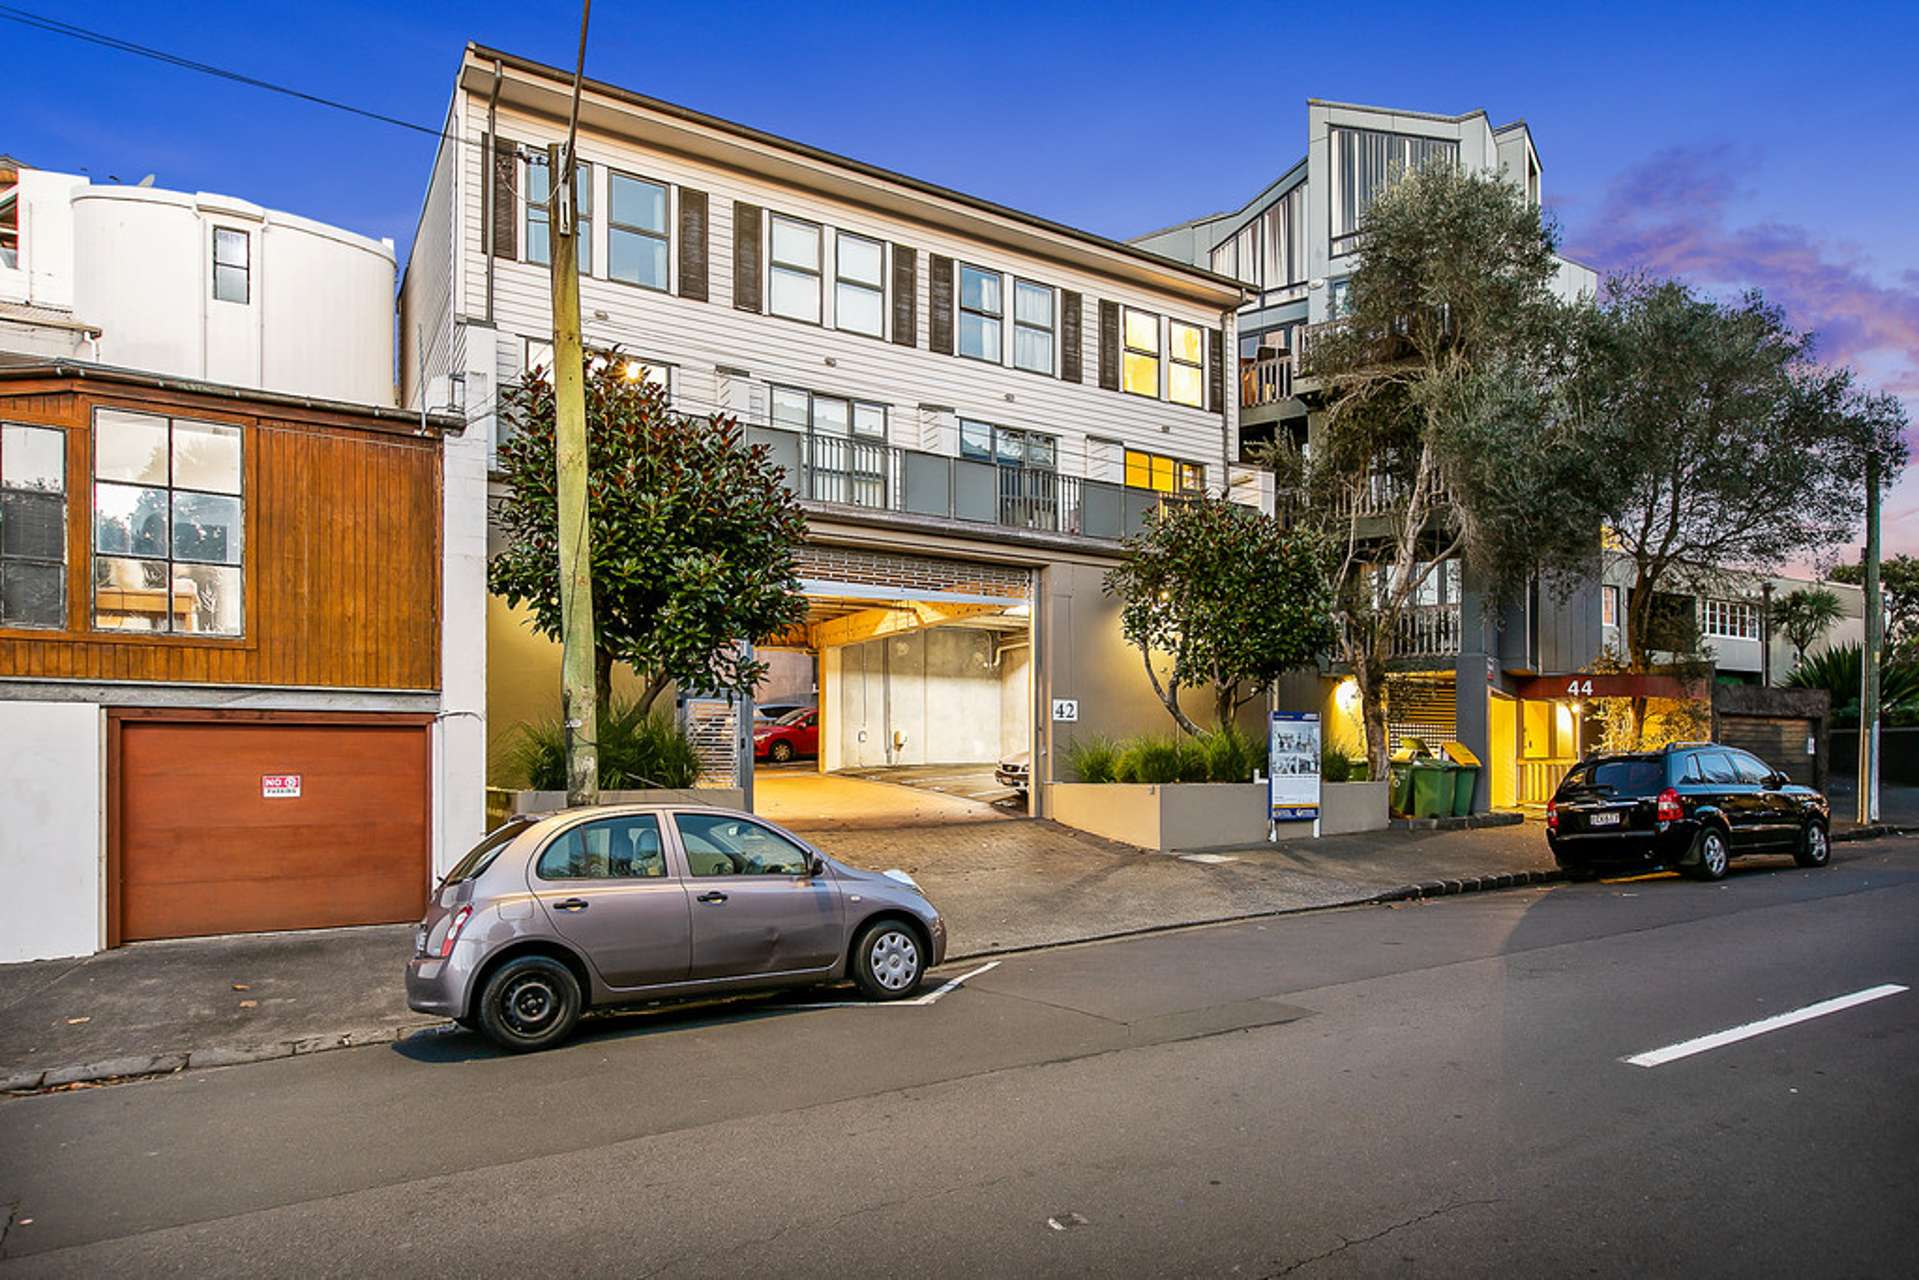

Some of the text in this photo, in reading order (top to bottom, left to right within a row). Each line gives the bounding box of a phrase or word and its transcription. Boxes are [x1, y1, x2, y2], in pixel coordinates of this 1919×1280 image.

[1567, 680, 1593, 696] 44
[1055, 702, 1074, 718] 42
[264, 778, 281, 787] NO
